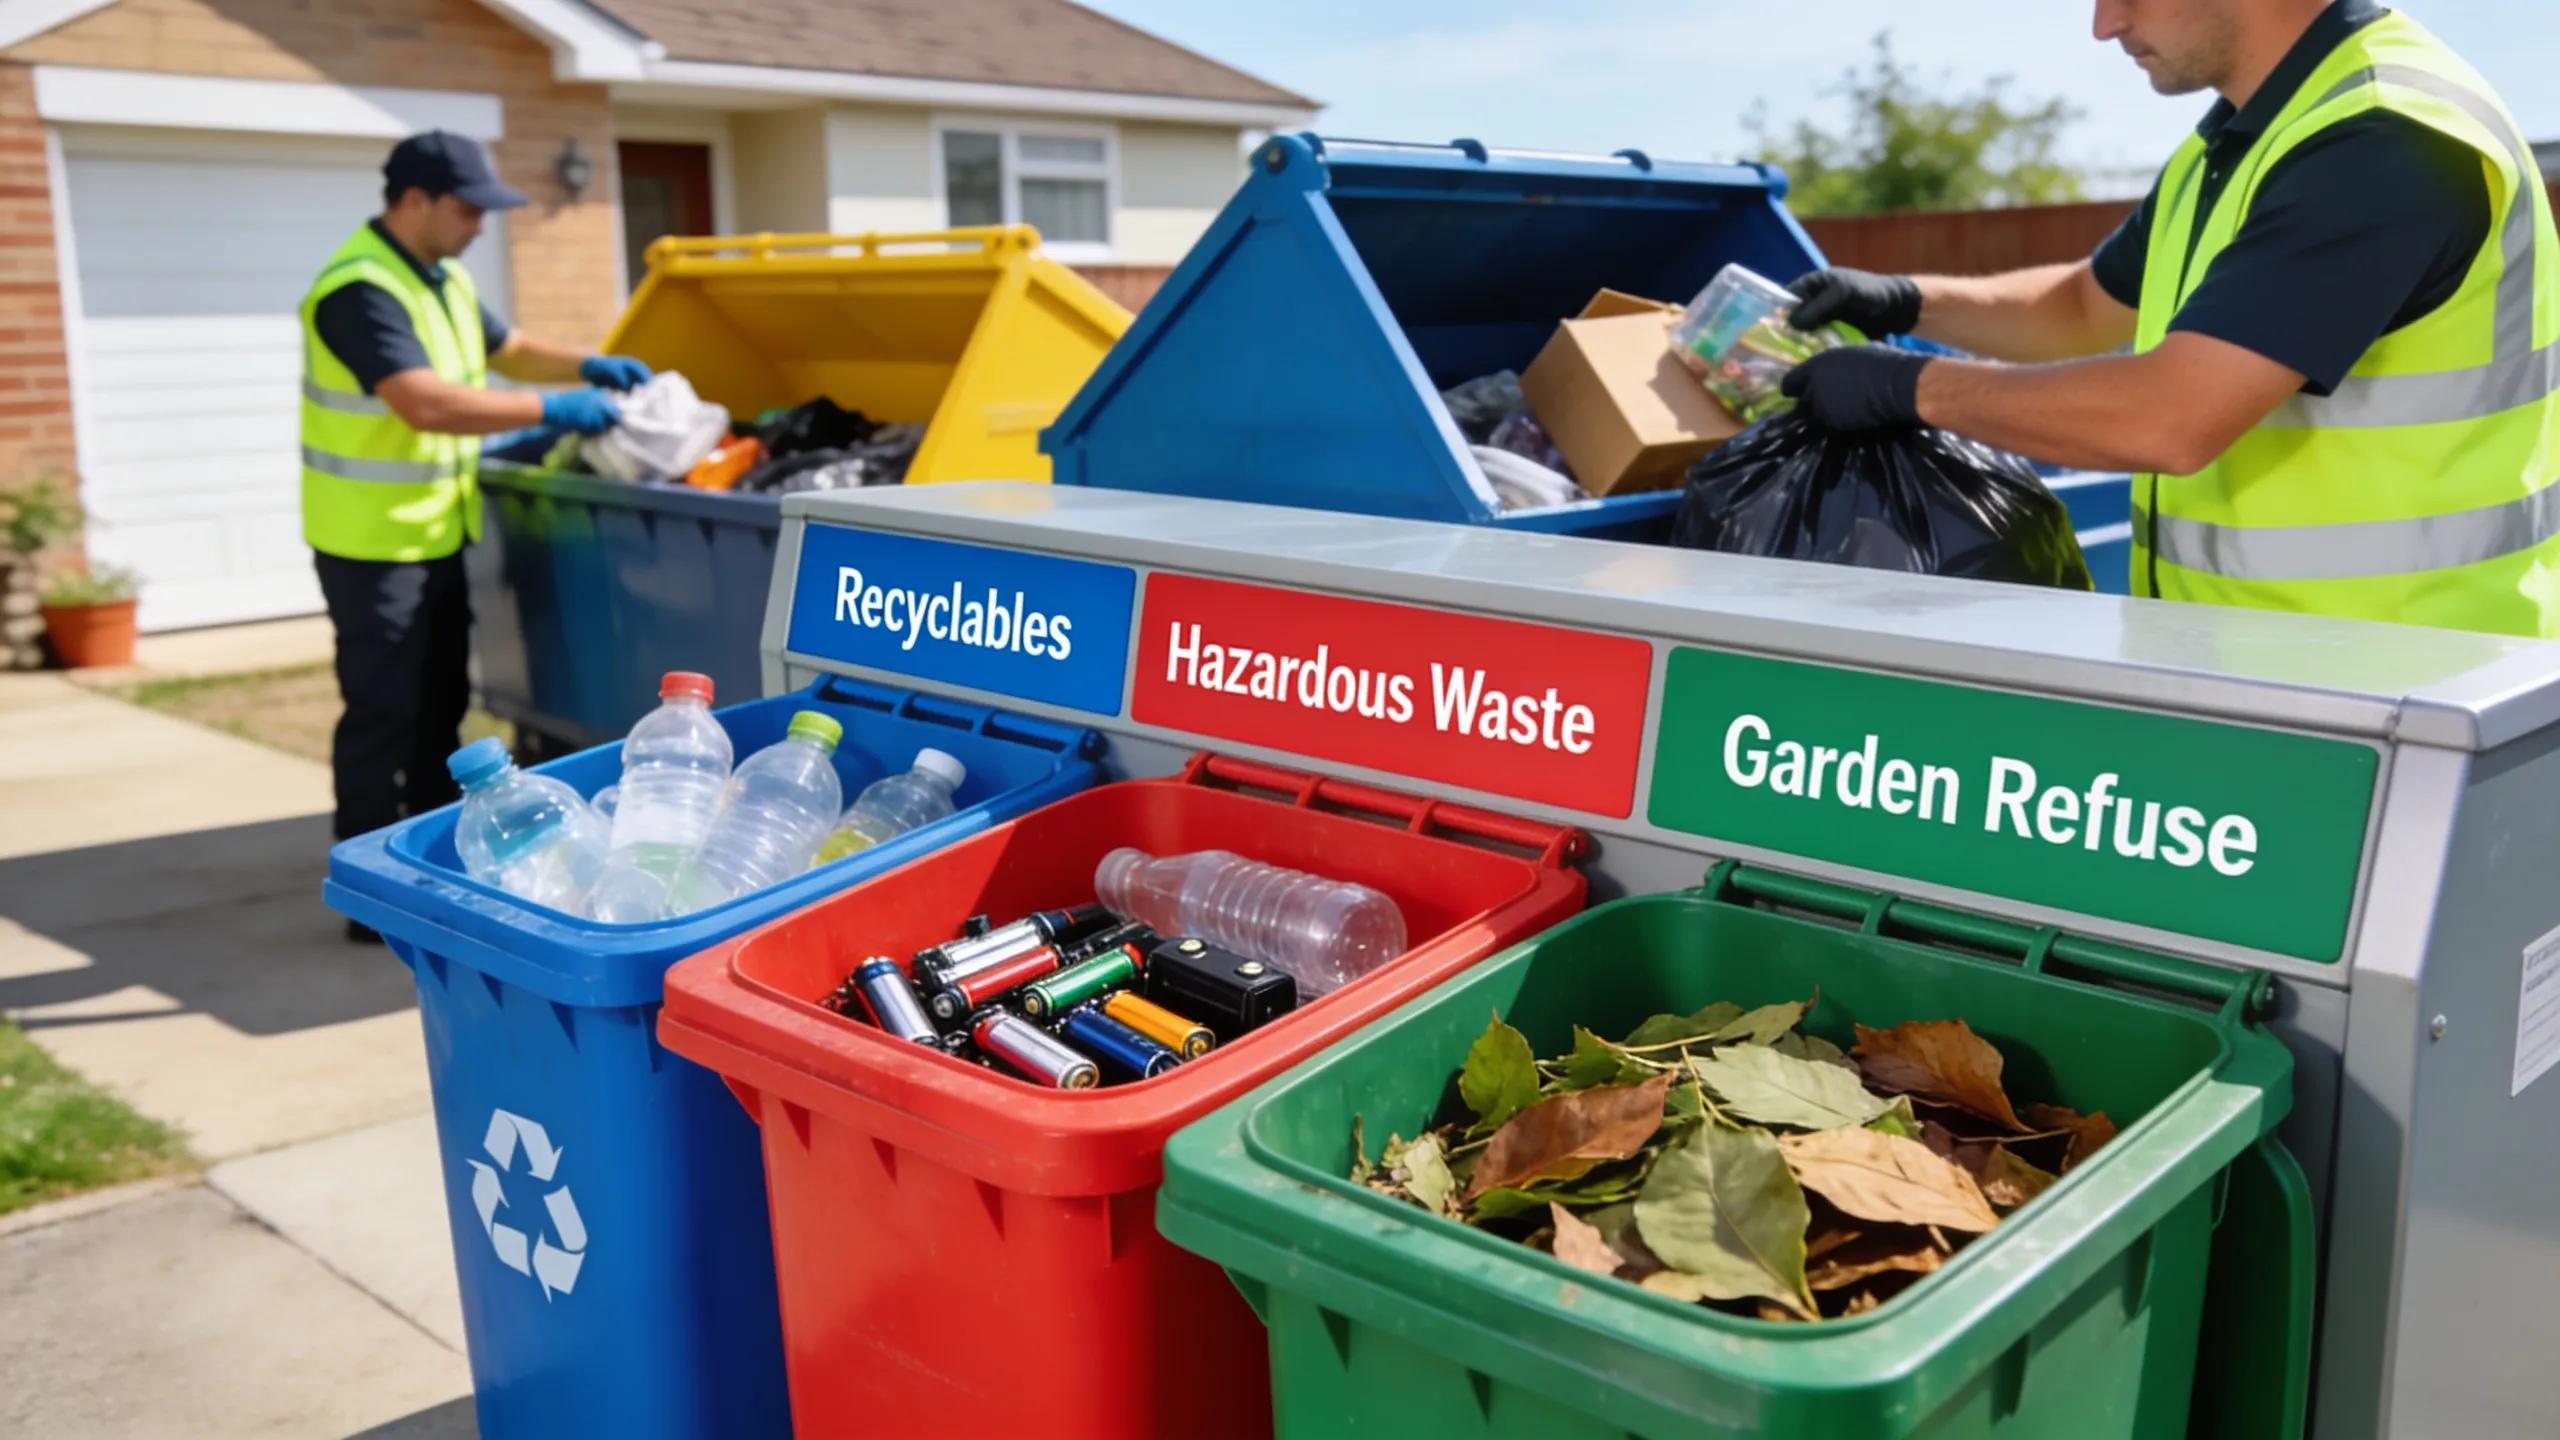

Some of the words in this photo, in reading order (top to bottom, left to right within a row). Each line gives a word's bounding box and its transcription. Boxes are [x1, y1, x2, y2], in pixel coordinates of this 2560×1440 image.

[834, 566, 1072, 661] Recyclables
[1166, 621, 1414, 723] Hazardous
[1431, 663, 1595, 754] Waste
[1723, 714, 1960, 824] Garden
[1985, 756, 2257, 876] Refuse
